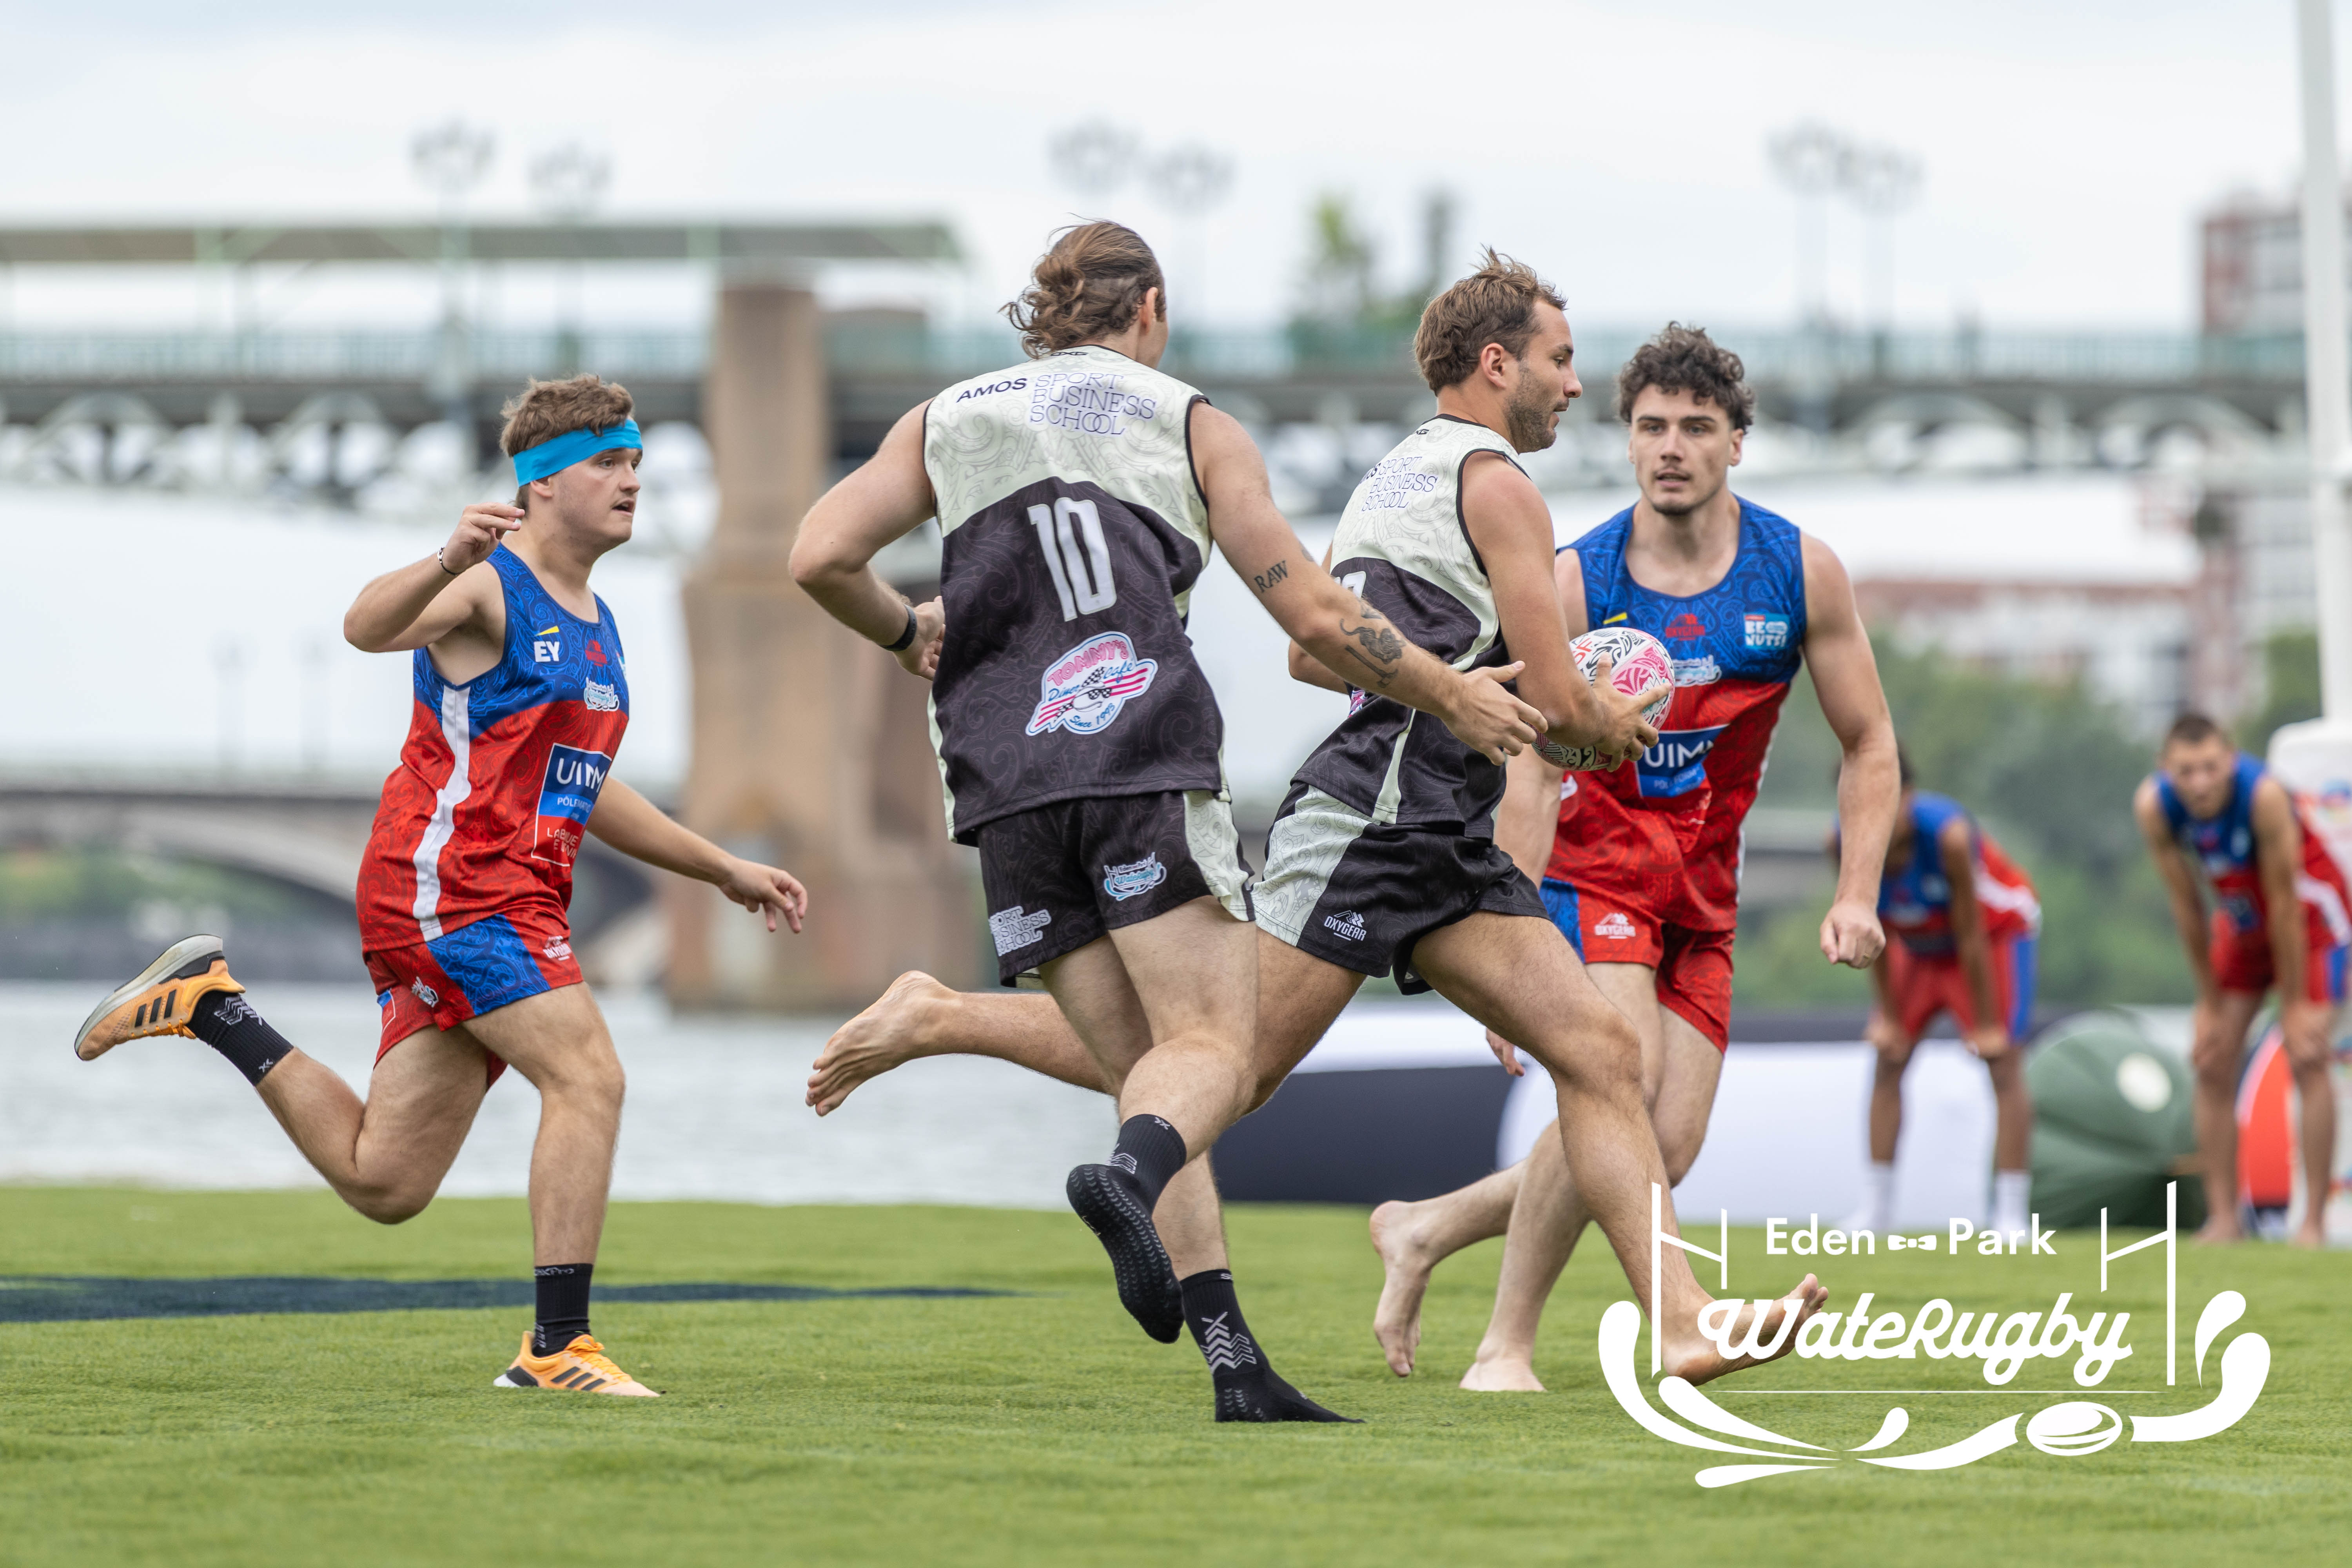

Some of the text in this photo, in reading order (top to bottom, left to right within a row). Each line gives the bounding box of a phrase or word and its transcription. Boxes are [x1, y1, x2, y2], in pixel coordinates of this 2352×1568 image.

[956, 372, 1124, 403] AMOS SPORT
[1031, 386, 1157, 419] BUSINESS
[1030, 405, 1126, 435] SCHOOL
[1379, 457, 1423, 475] SPORT
[1370, 473, 1438, 494] BUSINESS
[1361, 492, 1409, 512] SCHOOL
[1027, 497, 1117, 622] 10
[1254, 560, 1289, 593] RAW
[1745, 621, 1765, 634] BE
[534, 641, 560, 662] EY
[1047, 640, 1129, 686] TOMMY'S
[1048, 685, 1080, 701] Diner
[1069, 715, 1093, 727] Since
[993, 912, 1049, 941] SINESS
[1324, 916, 1367, 941] OXYGEAR
